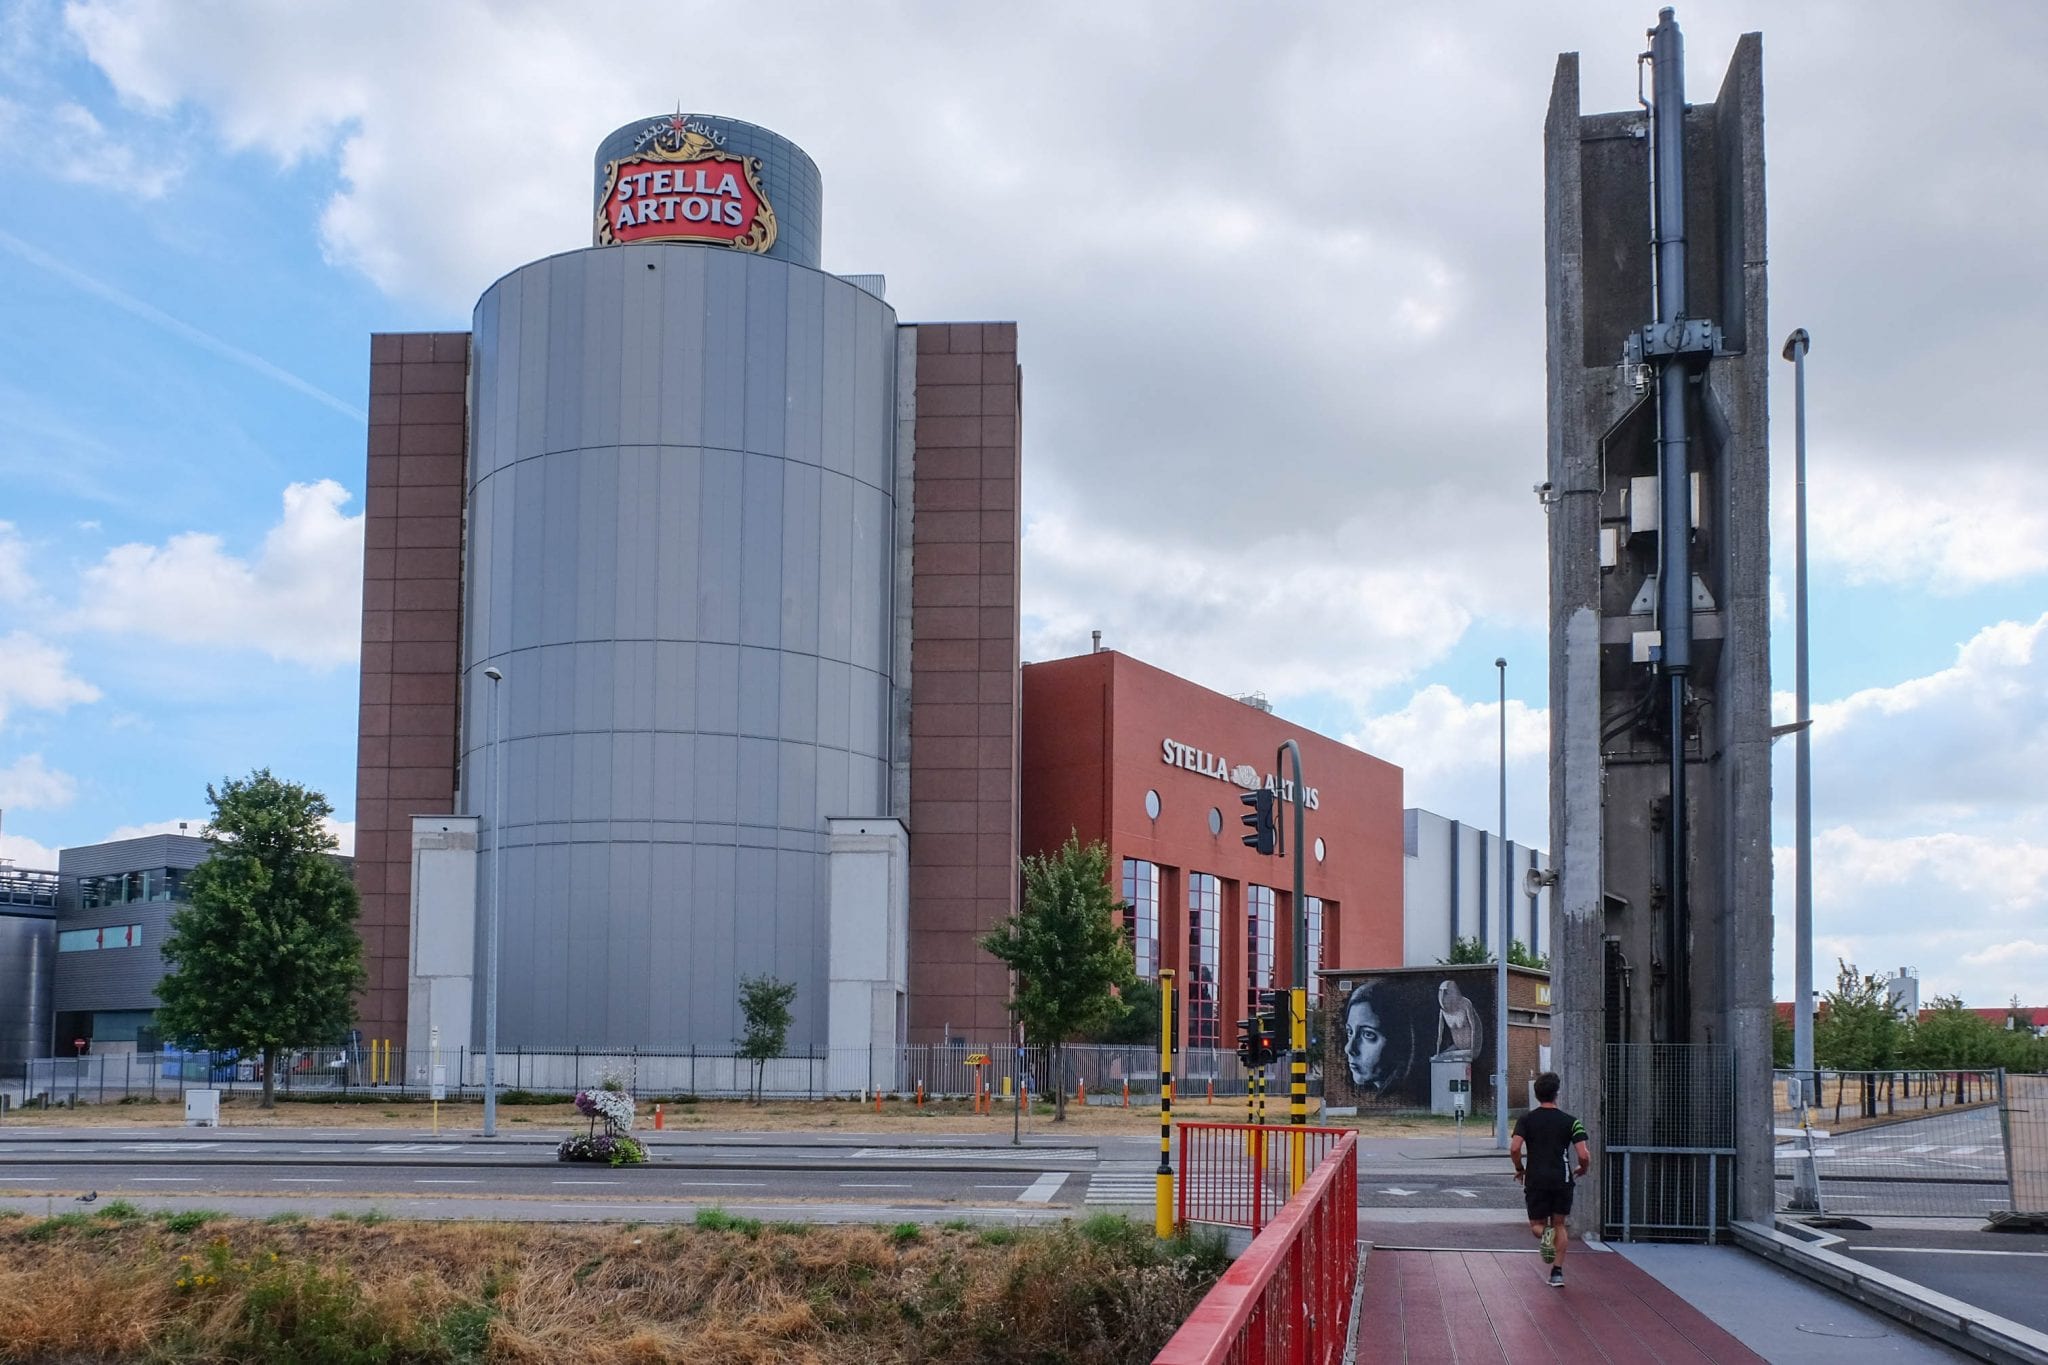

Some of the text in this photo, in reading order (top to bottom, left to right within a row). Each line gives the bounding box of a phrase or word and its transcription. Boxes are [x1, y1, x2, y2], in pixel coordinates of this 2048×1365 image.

[617, 169, 742, 201] STELLA
[616, 198, 743, 230] ARTOIS
[1162, 738, 1319, 810] STELLA ARTIS
